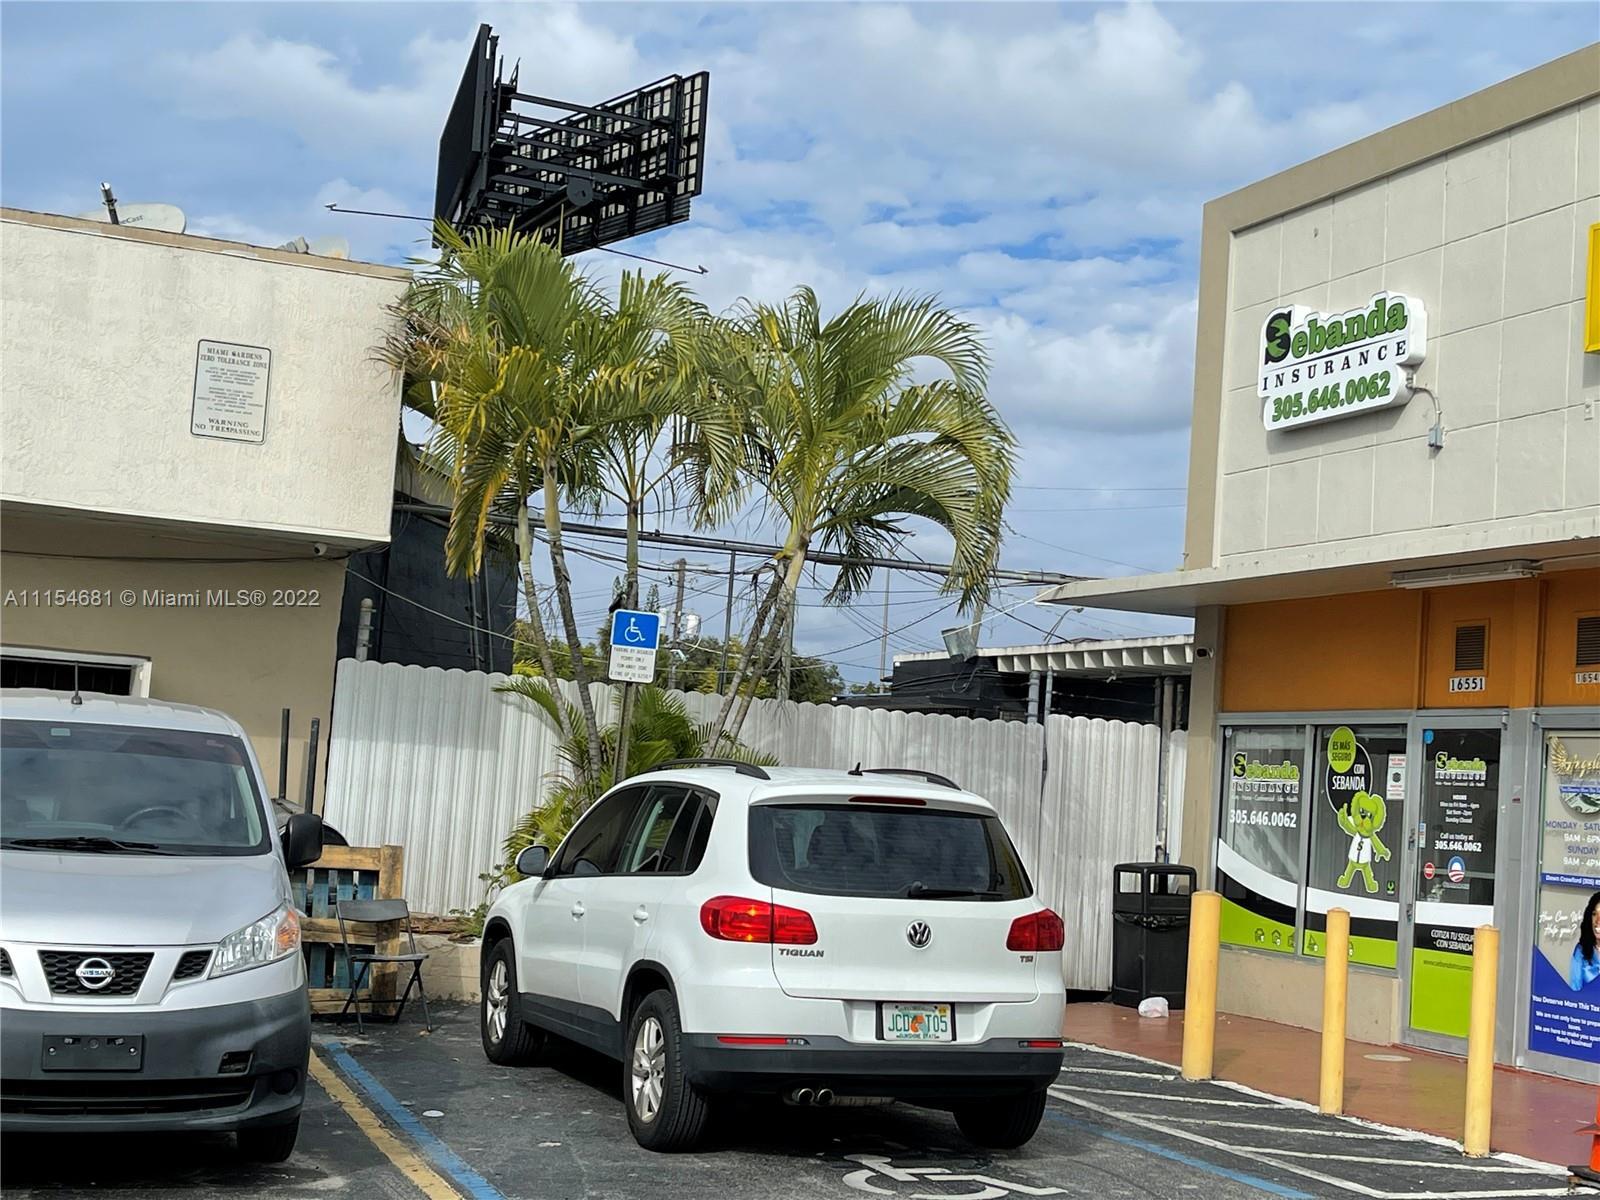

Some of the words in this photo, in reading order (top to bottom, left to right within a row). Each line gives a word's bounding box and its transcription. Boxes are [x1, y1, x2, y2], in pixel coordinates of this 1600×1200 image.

[1264, 297, 1408, 365] Sebanda
[1262, 340, 1406, 391] INSURANCE
[1272, 370, 1391, 422] 305.646.0062
[208, 418, 249, 428] WARNING
[211, 425, 261, 436] TRESPASSING
[1451, 677, 1484, 691] 16551
[1332, 741, 1339, 750] ES
[1331, 751, 1352, 762] SEGURO
[1233, 752, 1300, 780] Sebanda
[1353, 763, 1365, 775] CON
[1232, 782, 1299, 794] INSURANCE
[1332, 776, 1366, 791] SEBANDA
[1229, 809, 1297, 828] 305.646.0062
[1545, 820, 1577, 829] MONDAY
[1564, 833, 1581, 842] 9AM
[1434, 840, 1482, 852] 305.646.0062
[1568, 846, 1599, 855] SUNDAY
[1563, 857, 1580, 866] 9AM
[778, 949, 825, 958] TIGUAN
[1019, 955, 1034, 963] TSI
[888, 1013, 910, 1032] JCD
